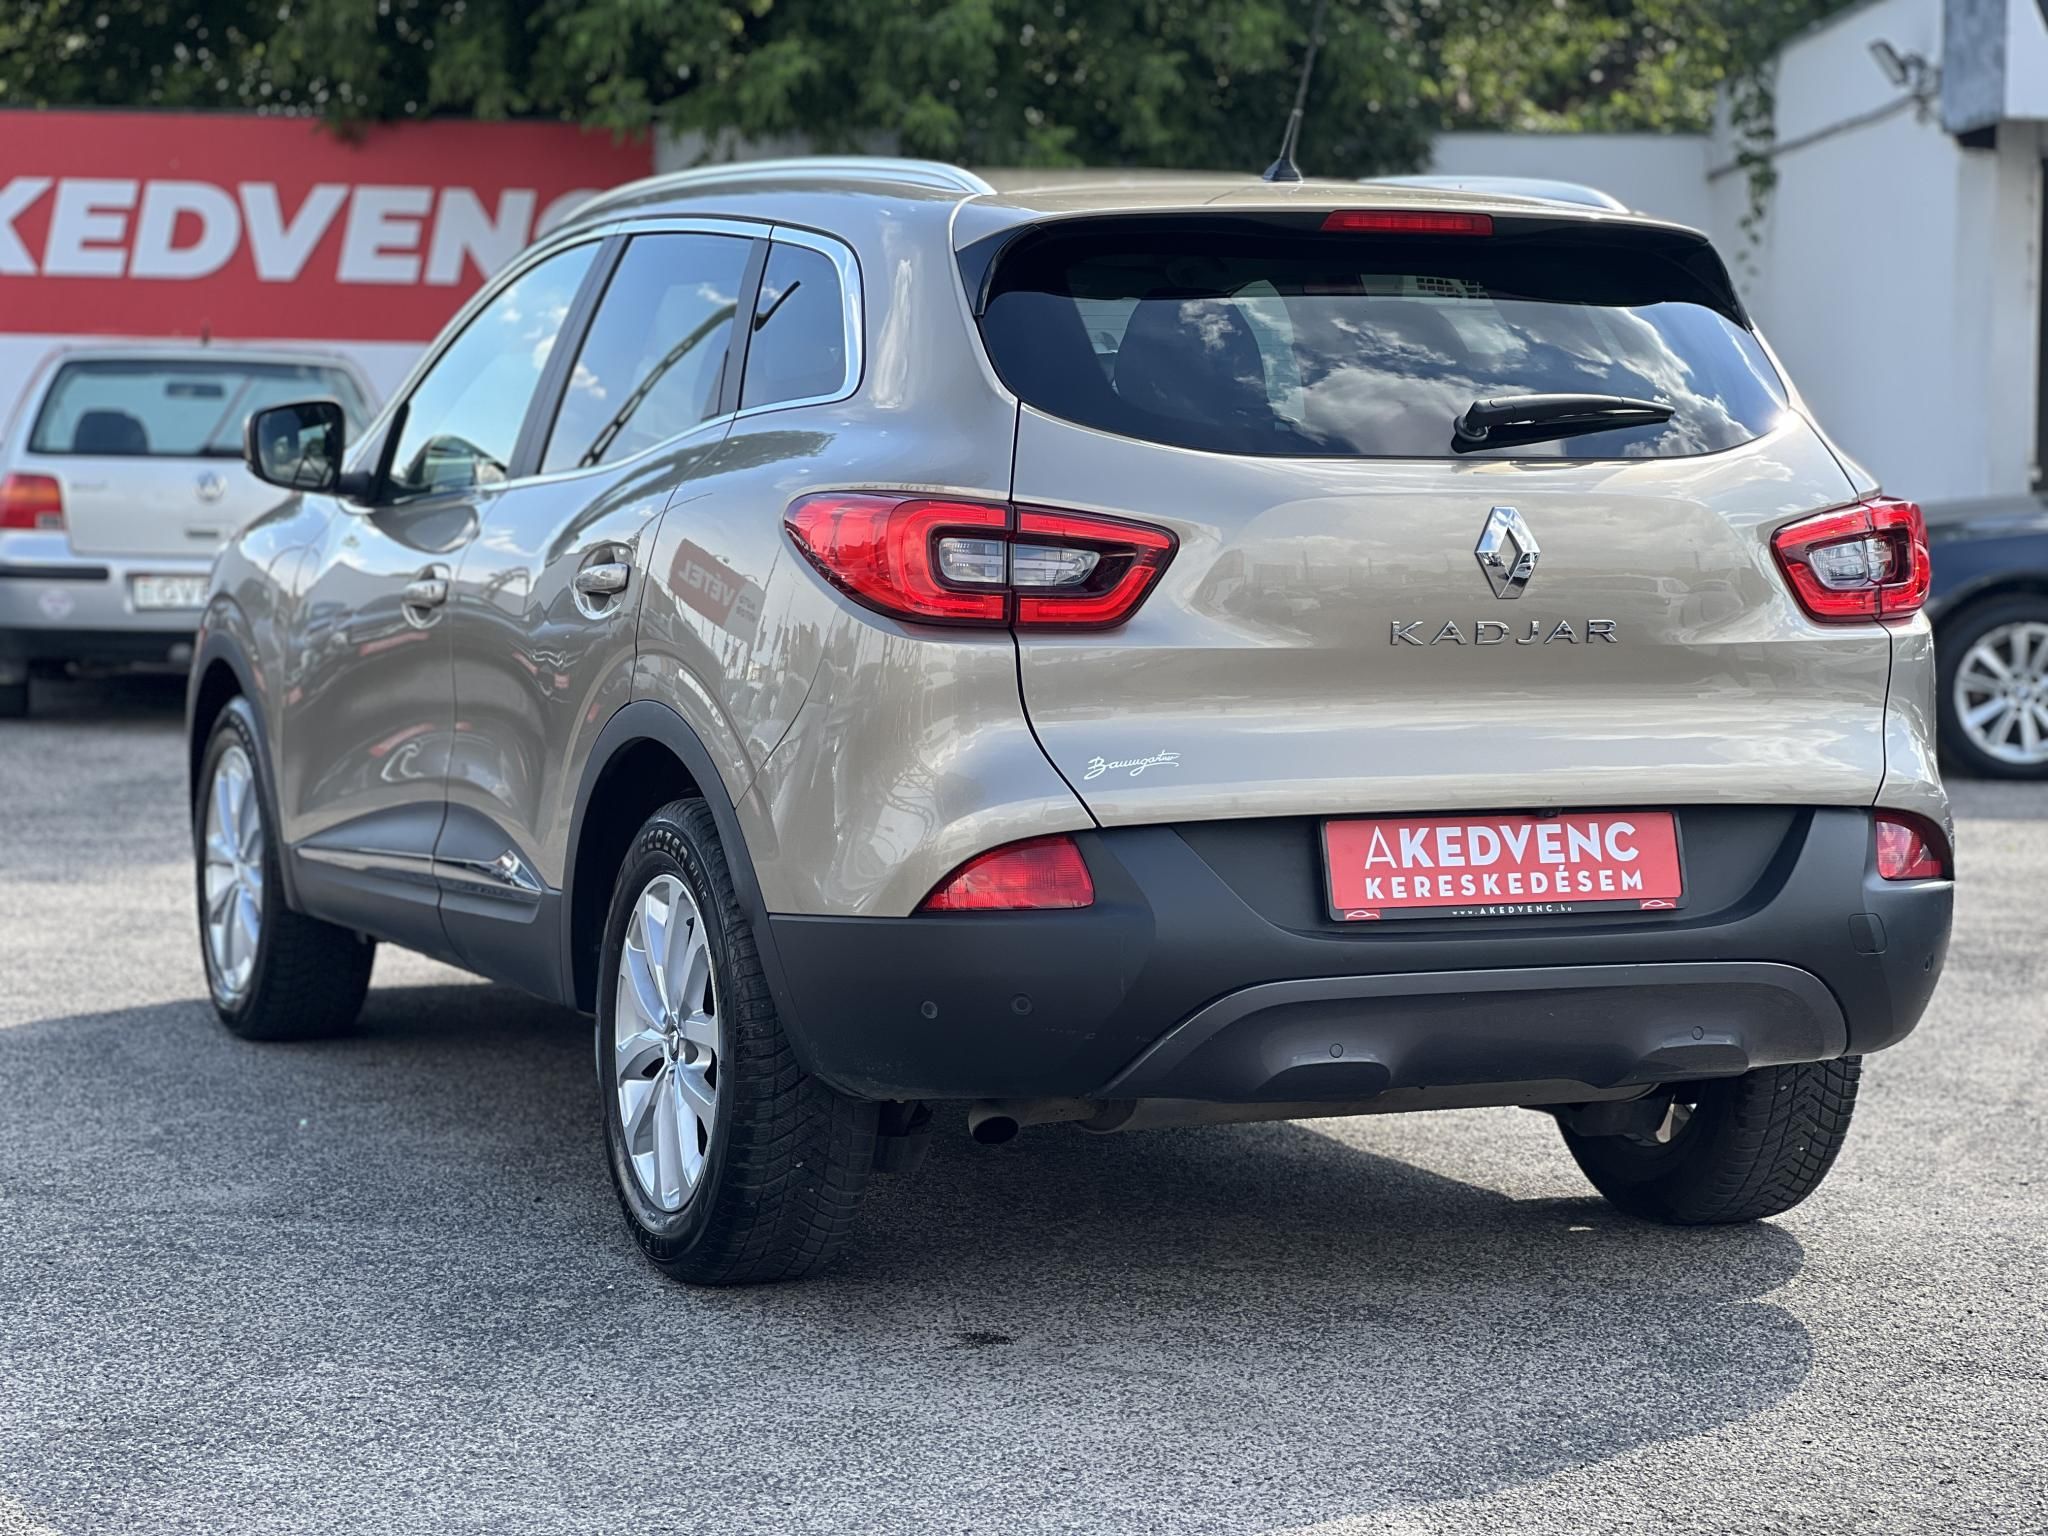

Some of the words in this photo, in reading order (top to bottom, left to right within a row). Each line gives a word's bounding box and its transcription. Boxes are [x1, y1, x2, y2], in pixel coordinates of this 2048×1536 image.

[1391, 619, 1618, 646] KADJAR
[1365, 822, 1639, 869] AKEDVENC
[1365, 865, 1643, 900] KERESKEDÉSEM
[1452, 904, 1572, 917] www.AKEDVENC.hu
